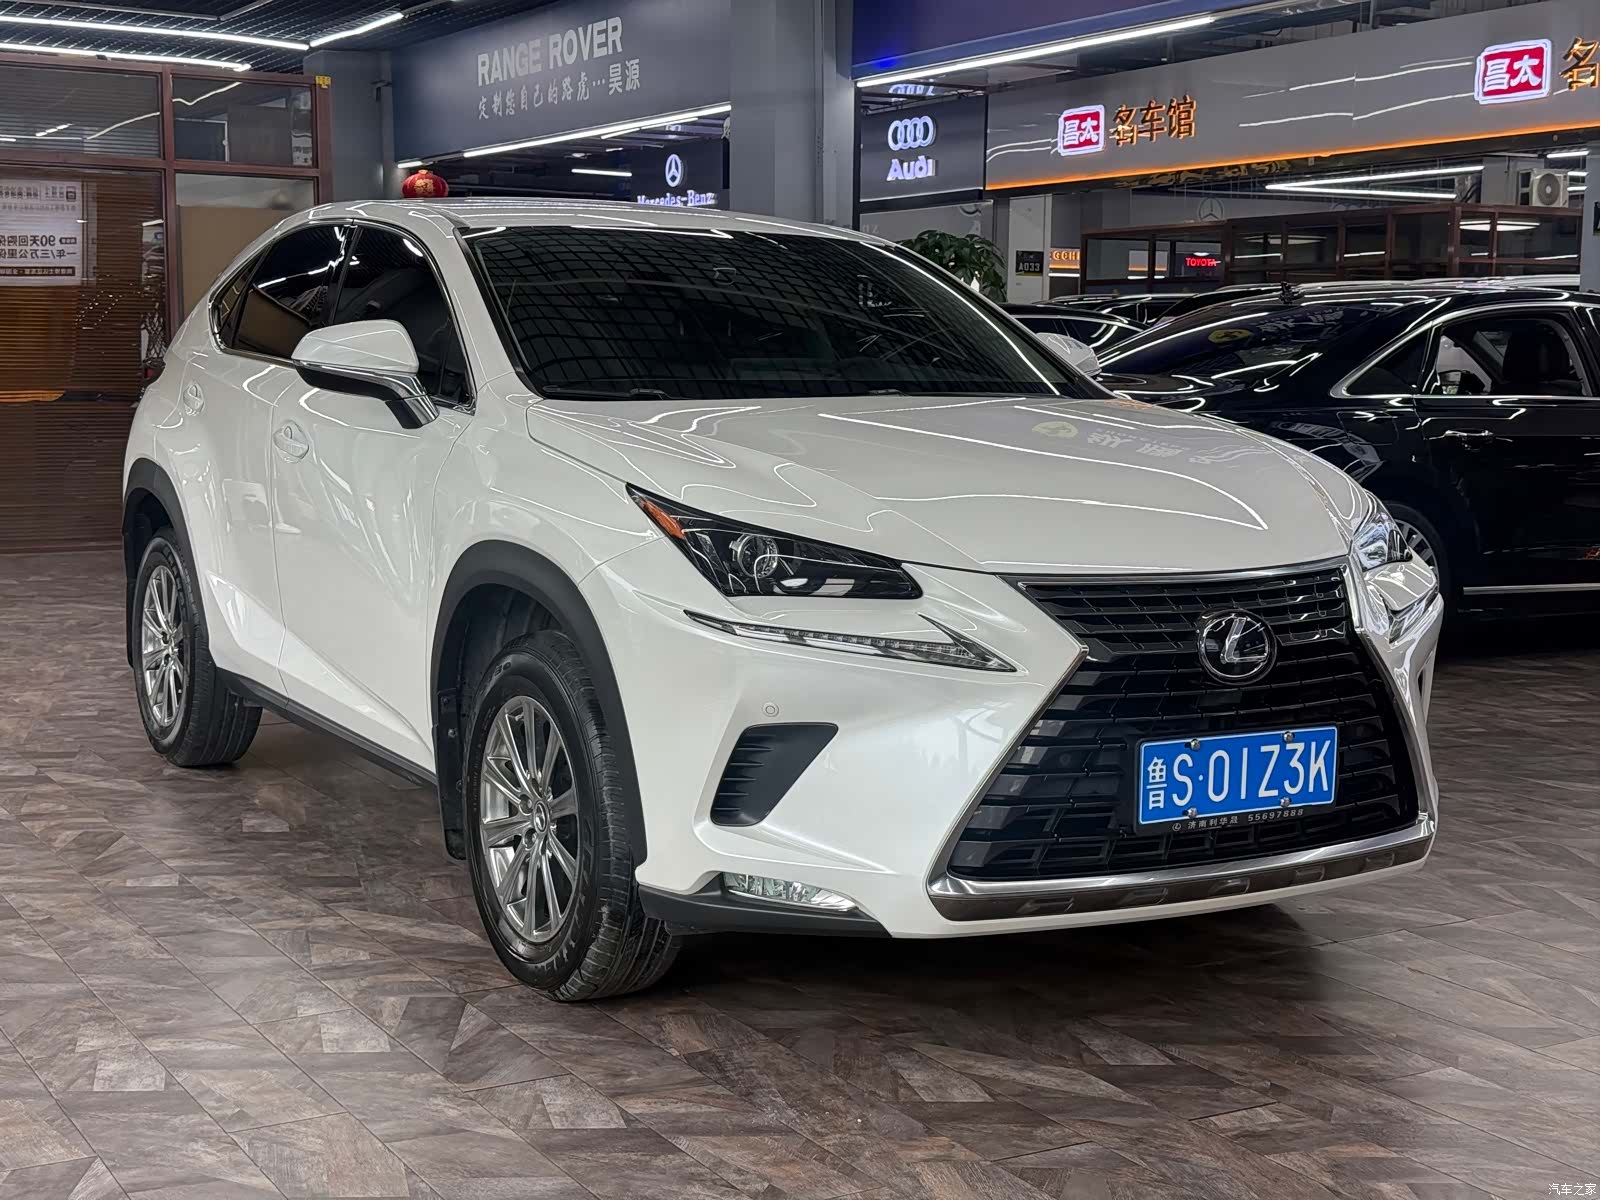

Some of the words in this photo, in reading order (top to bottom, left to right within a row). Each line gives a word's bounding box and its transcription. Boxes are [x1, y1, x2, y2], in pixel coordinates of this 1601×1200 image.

[477, 38, 542, 87] RANGE
[550, 16, 623, 70] ROVER
[1111, 95, 1197, 147] 名车馆
[886, 155, 935, 181] Audi
[1018, 262, 1041, 272] A033
[1185, 257, 1217, 267] TOYOTA
[1247, 808, 1304, 822] 55697888
